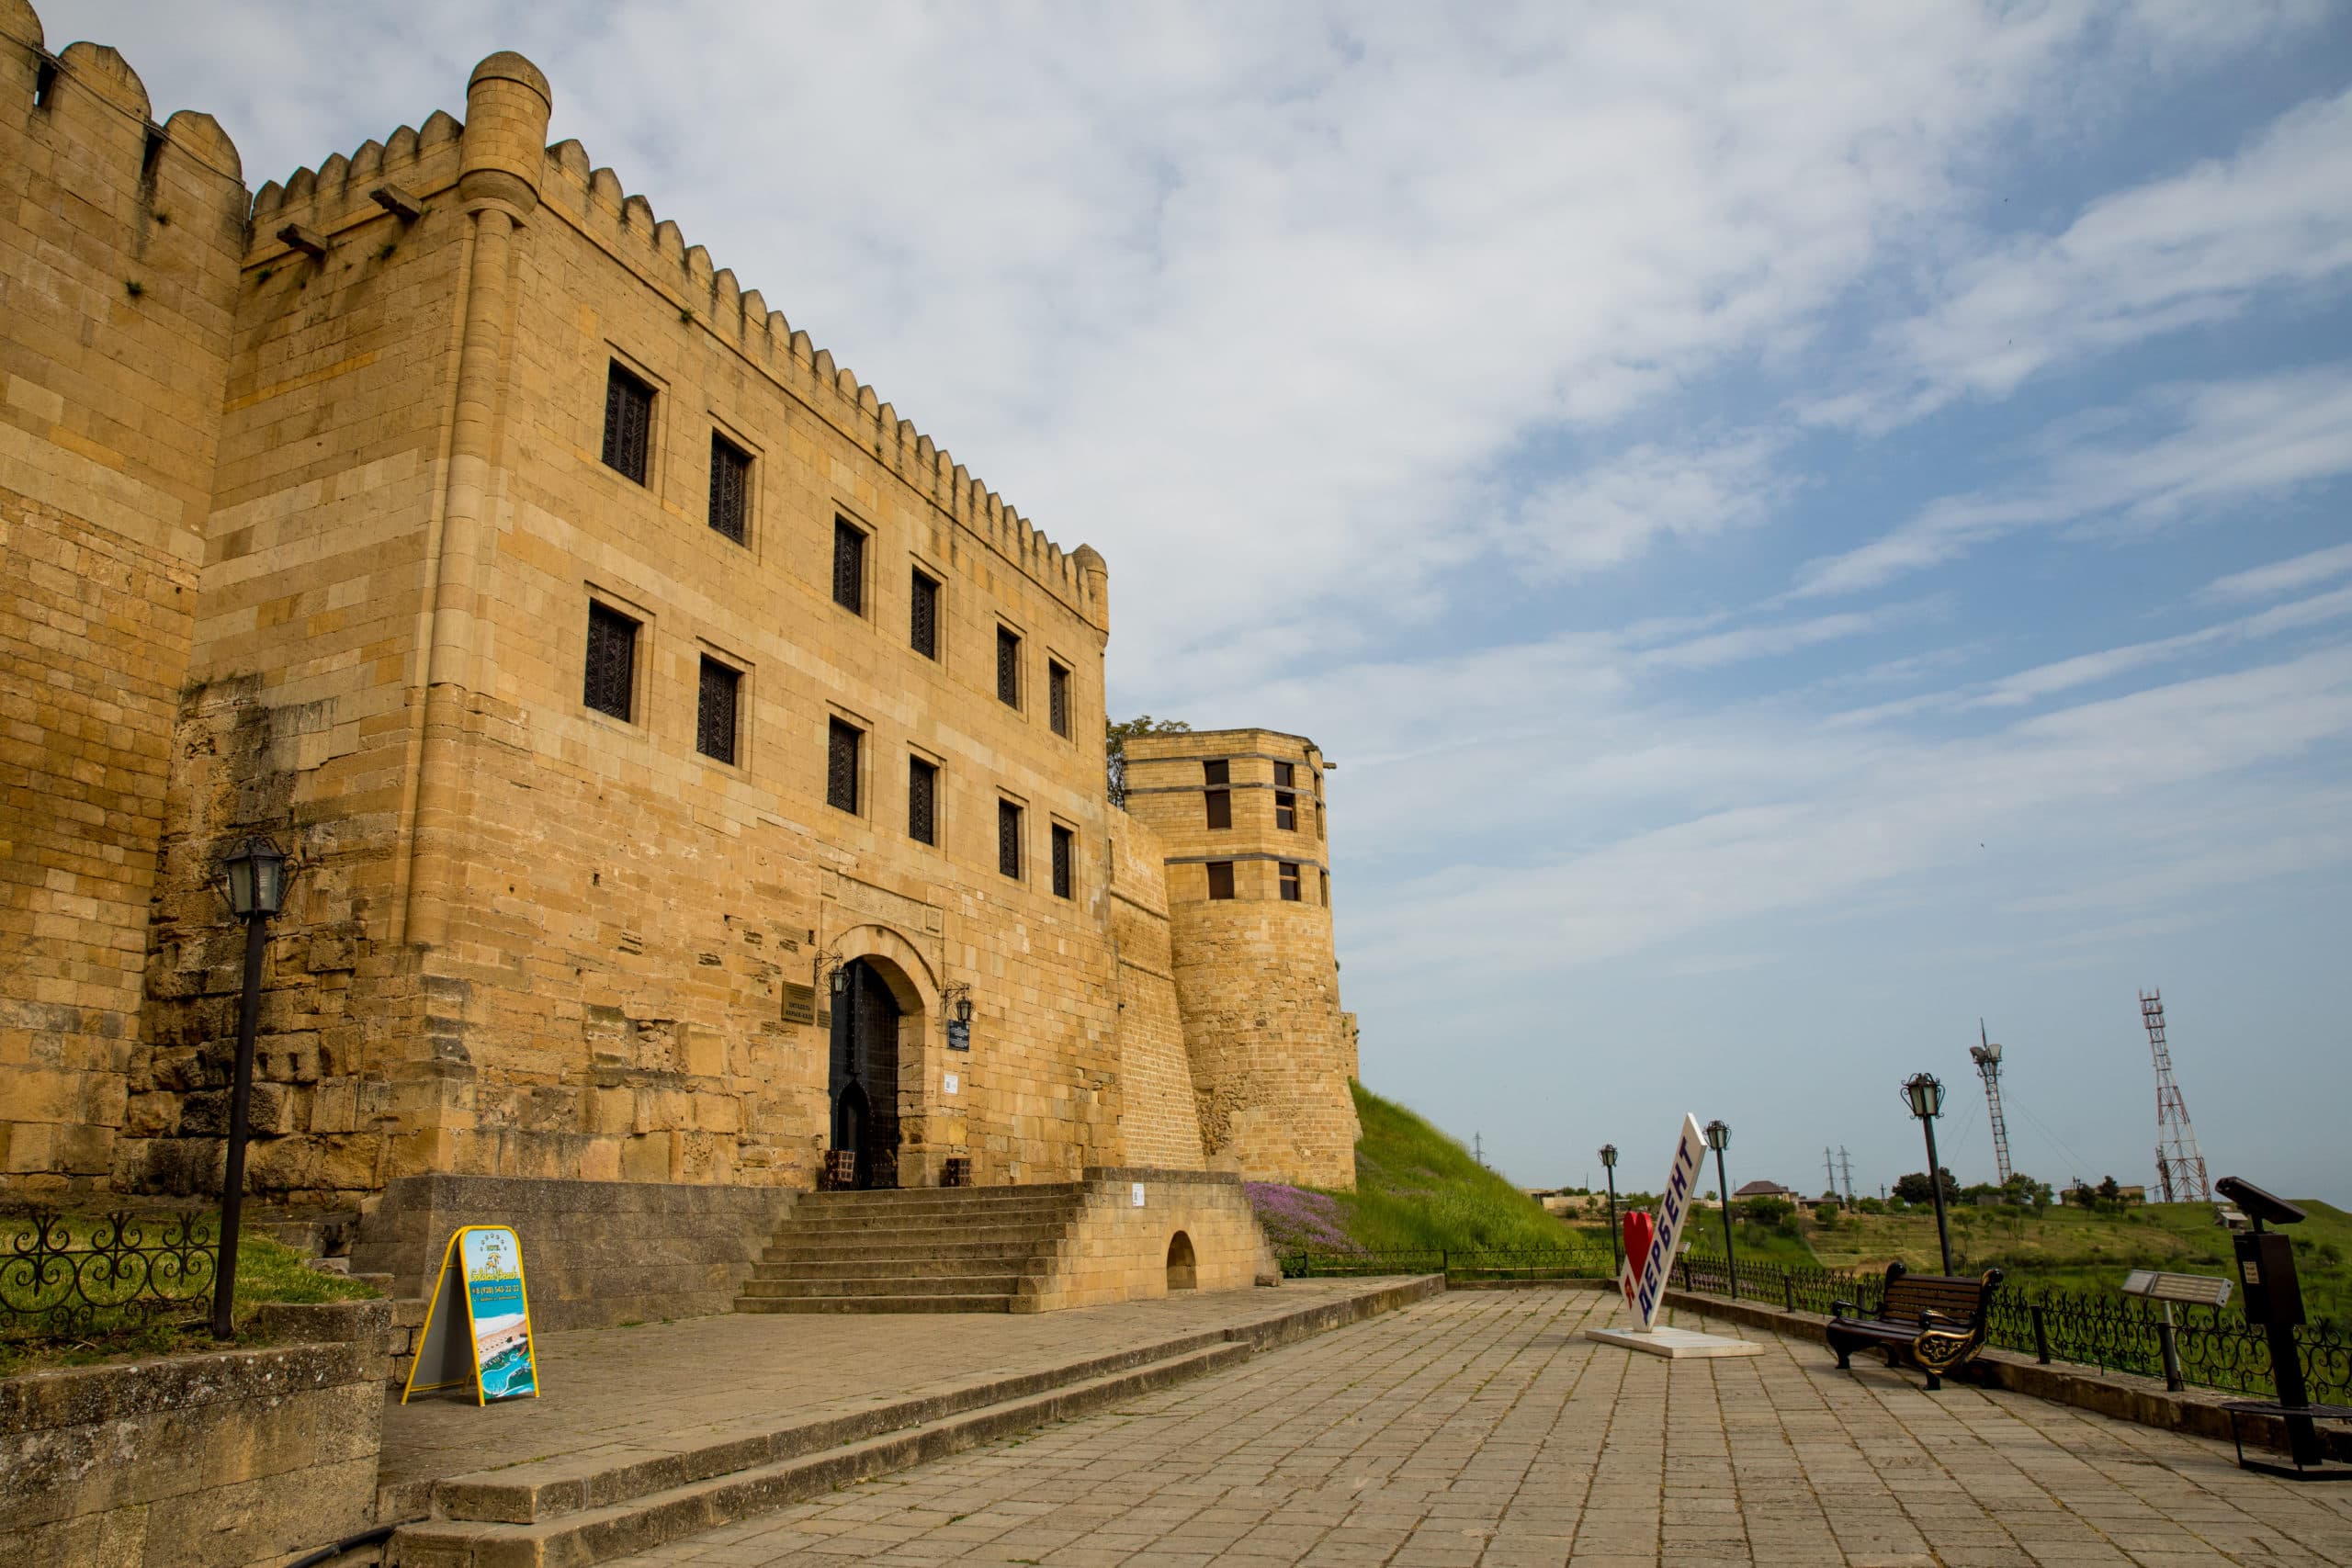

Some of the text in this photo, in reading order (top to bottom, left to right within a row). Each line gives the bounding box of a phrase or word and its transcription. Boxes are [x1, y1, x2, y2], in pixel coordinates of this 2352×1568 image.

[1639, 1135, 1693, 1326] ДЕРБЕНТ
[470, 1265, 518, 1282] Golden Beach
[1624, 1273, 1635, 1312] Я
